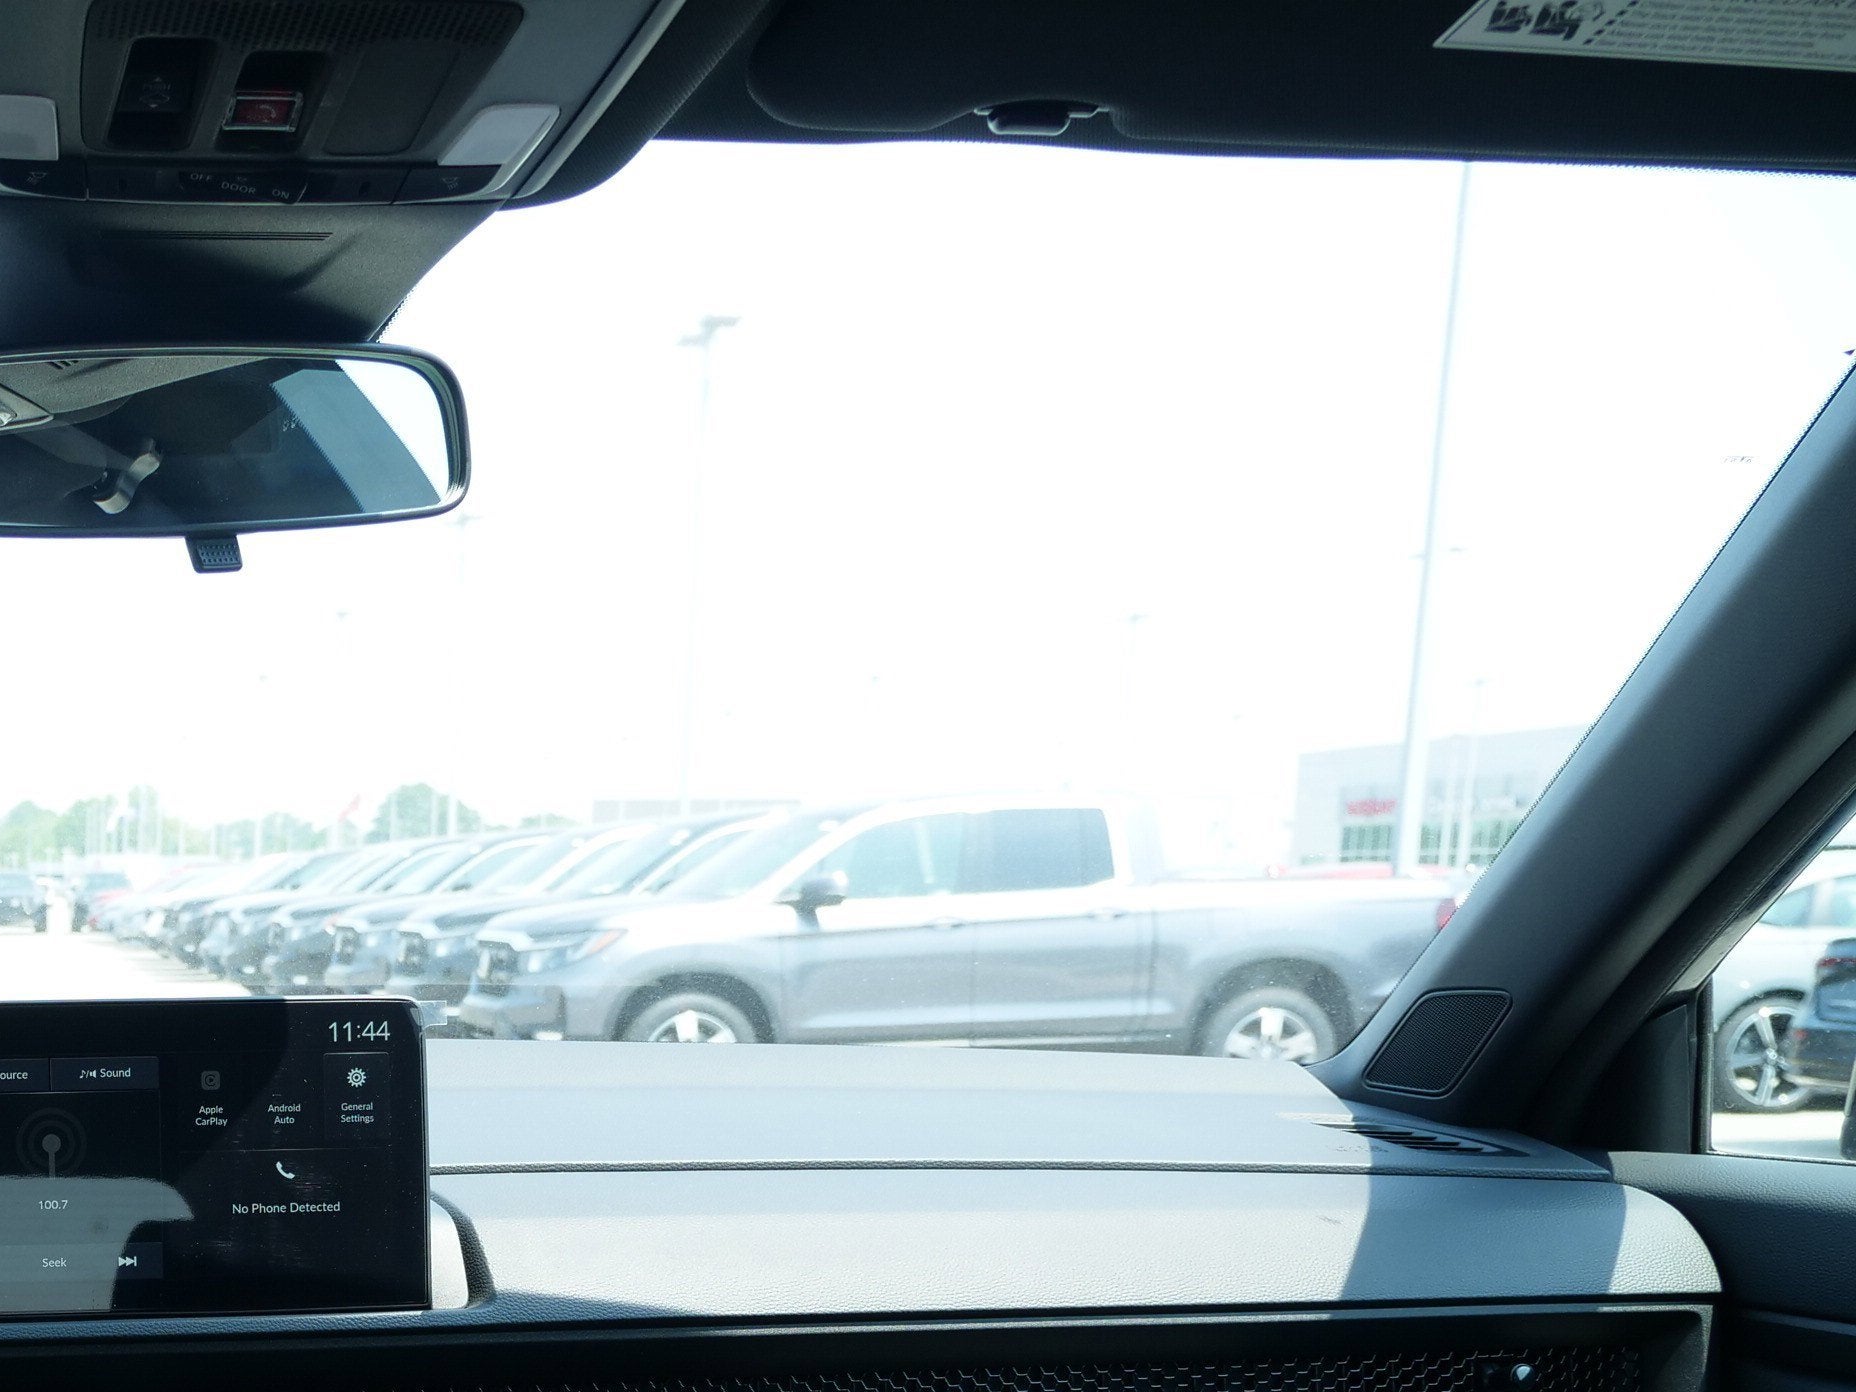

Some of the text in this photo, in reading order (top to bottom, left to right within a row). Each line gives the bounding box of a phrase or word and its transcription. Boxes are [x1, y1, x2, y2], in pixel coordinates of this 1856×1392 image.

[190, 172, 213, 181] OFF
[221, 181, 256, 195] DOOR
[271, 188, 290, 200] ON
[328, 1020, 391, 1042] 11:44
[100, 1067, 132, 1078] Sound
[199, 1105, 224, 1114] Apple
[268, 1104, 301, 1112] Android
[341, 1102, 373, 1111] General
[195, 1118, 228, 1126] CarPlay
[274, 1116, 294, 1124] Auto
[340, 1114, 374, 1124] Settings
[38, 1200, 68, 1210] 100.7
[232, 1201, 341, 1214] No Phone Detected
[42, 1258, 67, 1268] Seek
